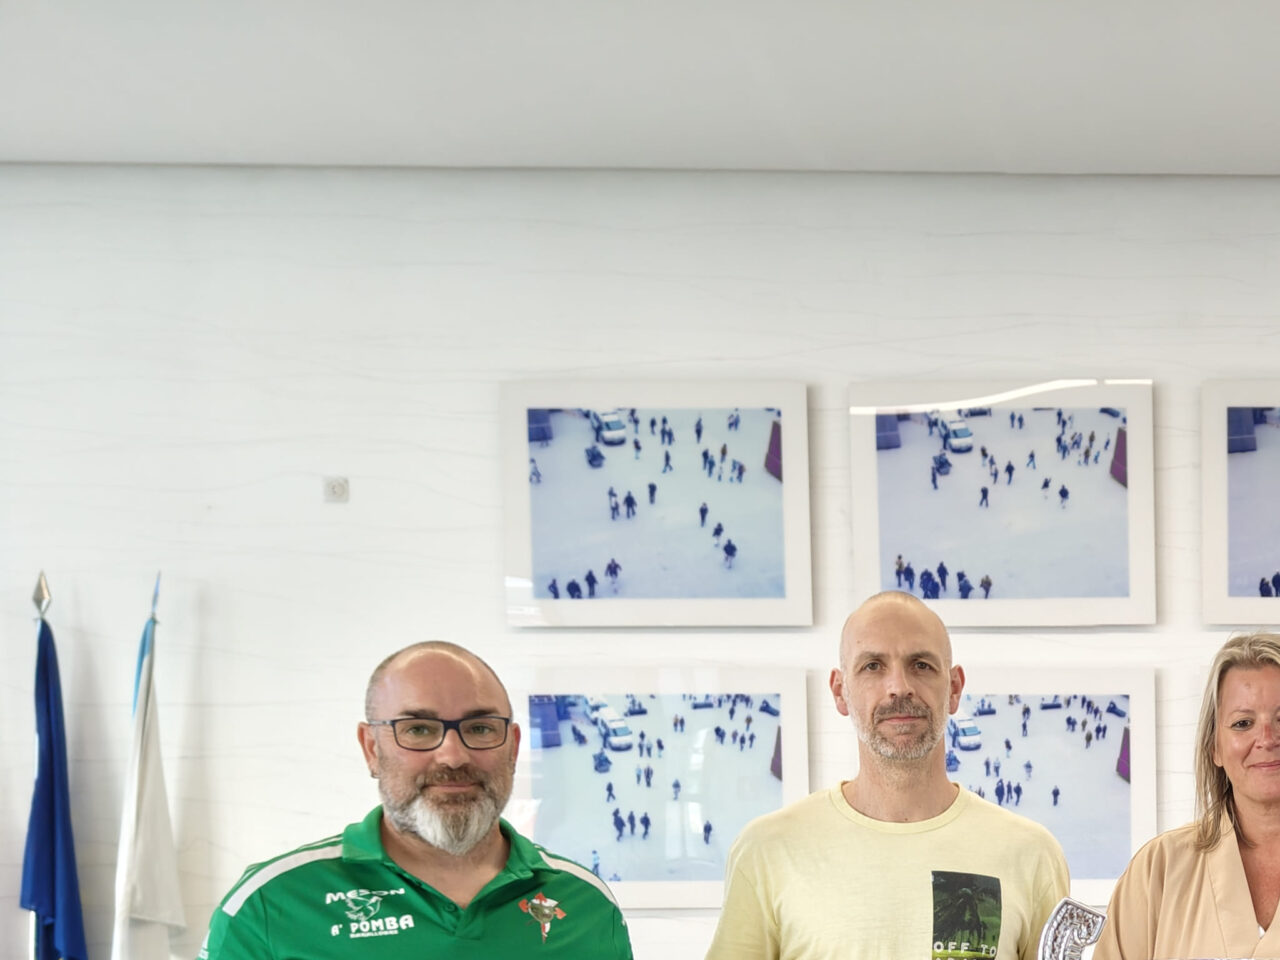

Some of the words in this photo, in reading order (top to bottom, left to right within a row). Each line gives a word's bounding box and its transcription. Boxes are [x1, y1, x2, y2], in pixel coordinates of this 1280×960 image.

[350, 914, 414, 933] POMBA
[934, 942, 970, 952] OFF
[981, 944, 996, 956] TO
